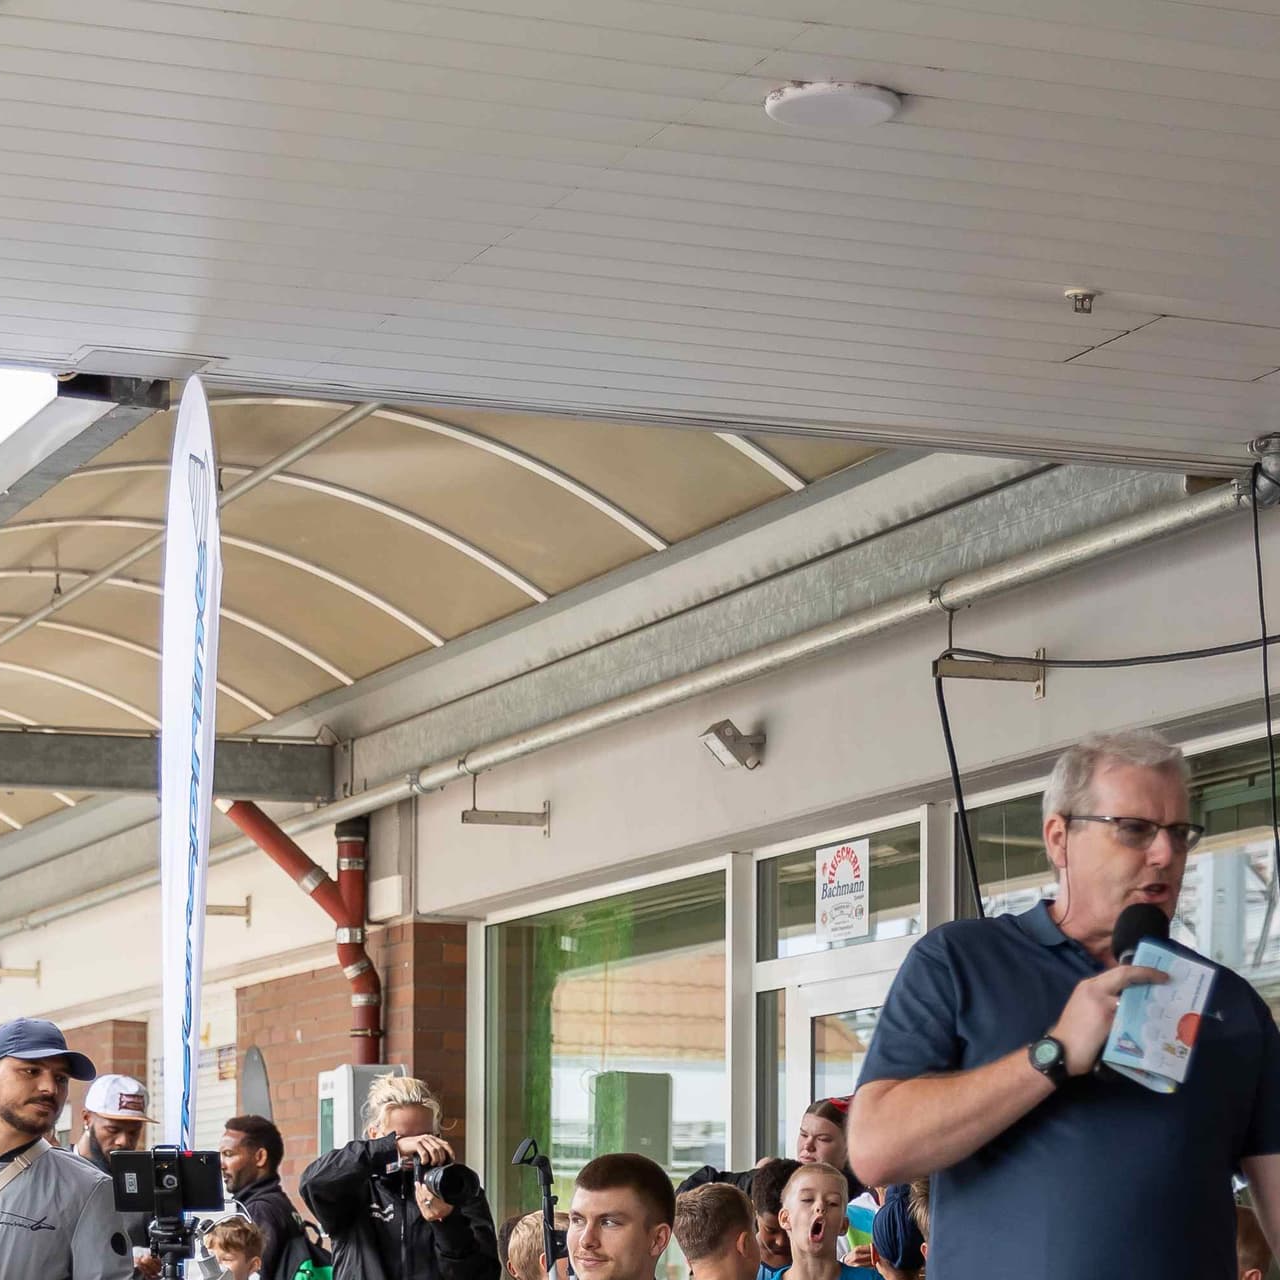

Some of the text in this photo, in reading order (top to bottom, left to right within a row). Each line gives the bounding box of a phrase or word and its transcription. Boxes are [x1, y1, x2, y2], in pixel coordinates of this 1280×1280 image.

[179, 539, 208, 1150] ndersprint
[828, 846, 861, 885] FLEISCHEREI
[821, 880, 865, 900] Bachmann
